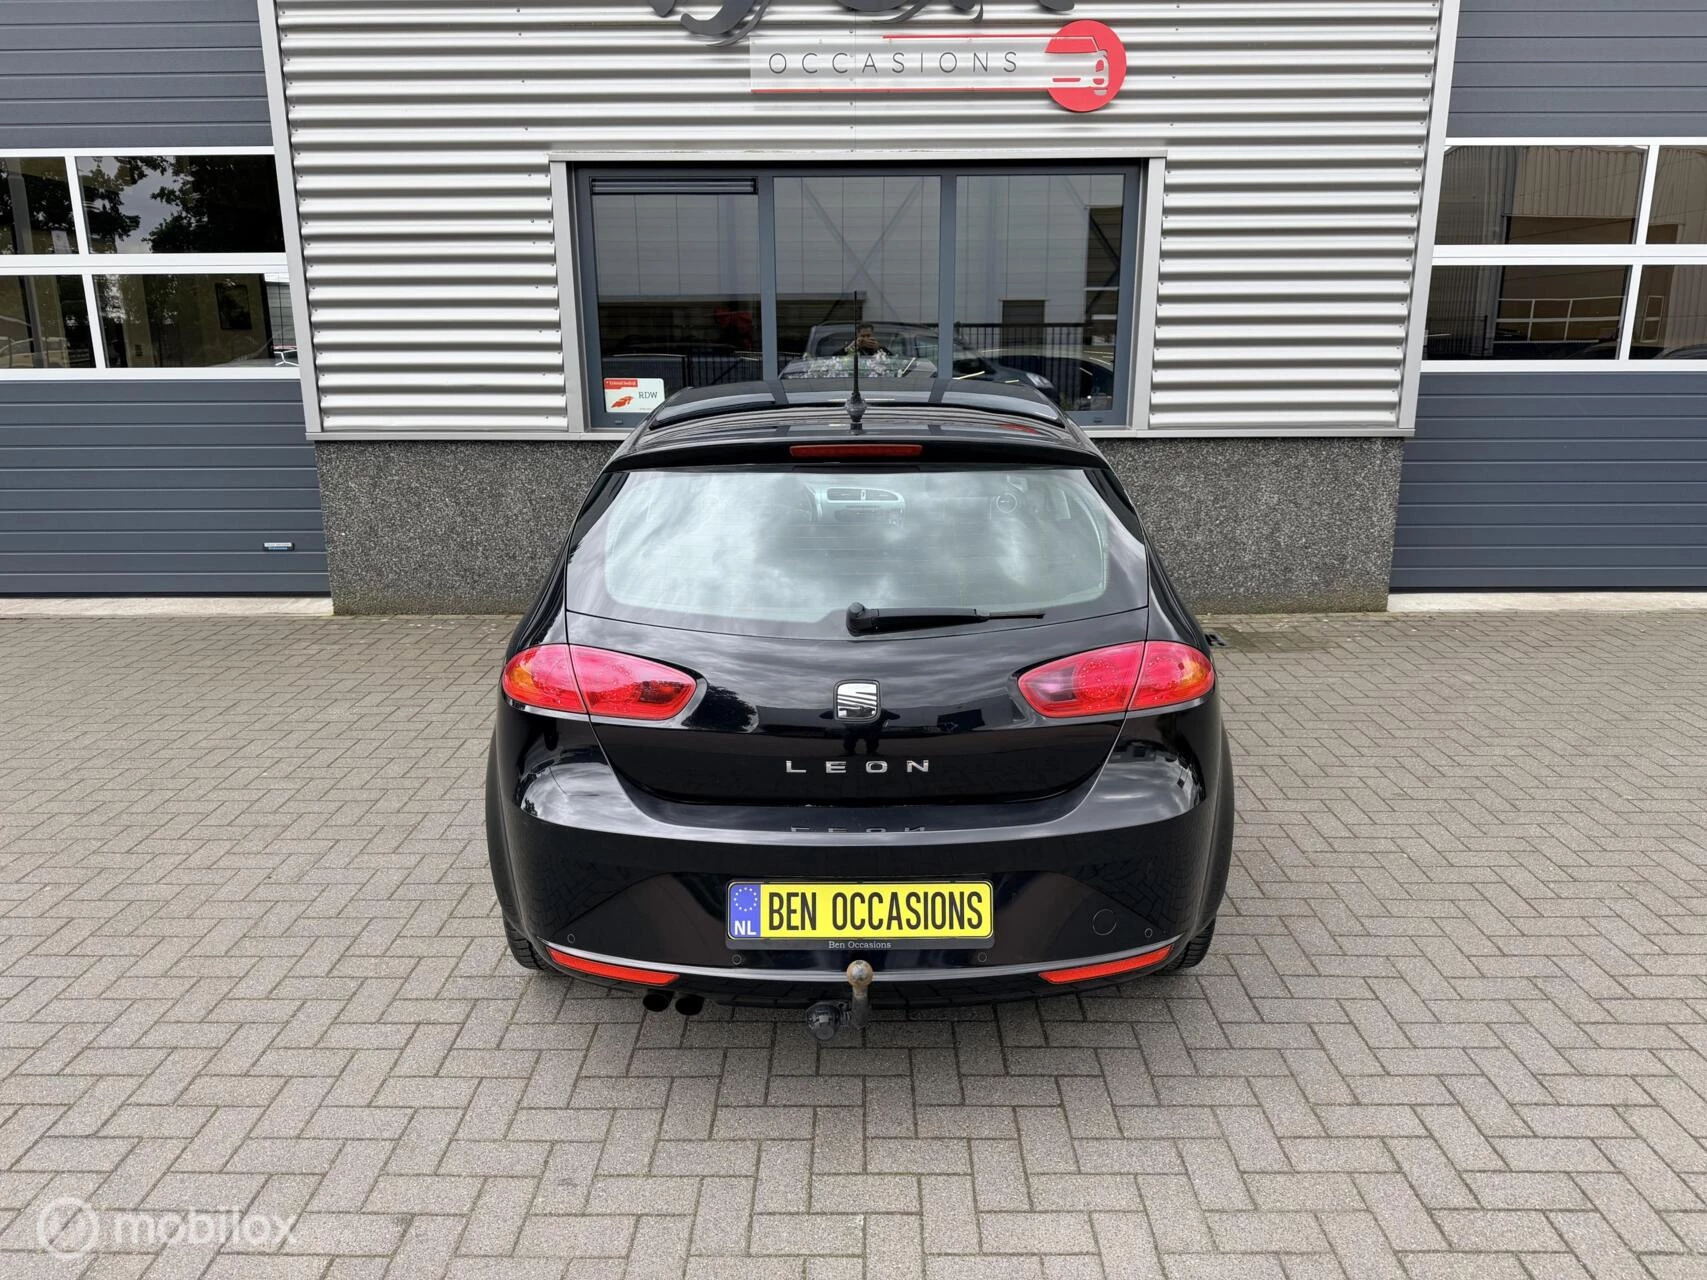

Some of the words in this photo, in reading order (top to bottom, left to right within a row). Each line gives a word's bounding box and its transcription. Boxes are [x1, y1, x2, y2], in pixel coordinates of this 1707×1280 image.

[768, 51, 1018, 75] OCCASIONS
[638, 391, 658, 399] RDW
[786, 760, 930, 774] LEON
[768, 892, 817, 931] BEN
[832, 891, 983, 931] OCCASIONS
[734, 920, 757, 936] NL
[828, 941, 846, 949] Ben
[848, 941, 892, 949] Occasions
